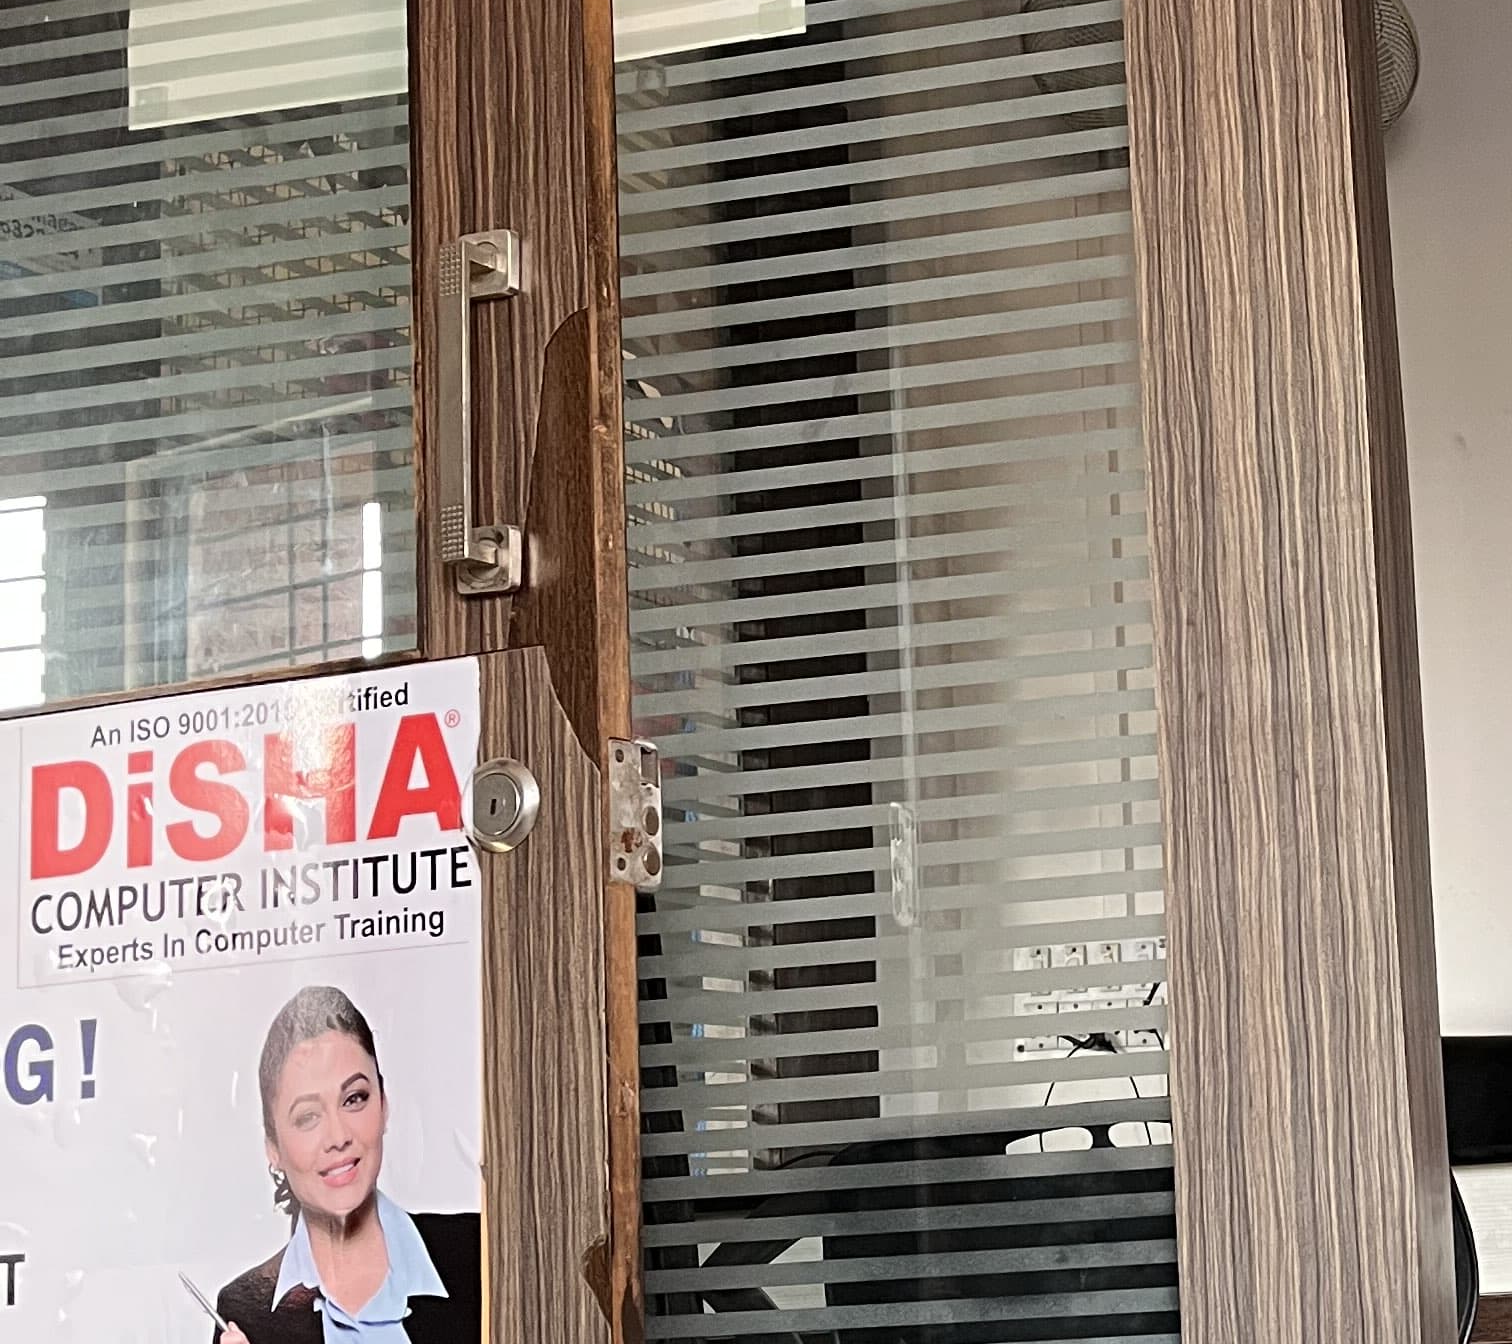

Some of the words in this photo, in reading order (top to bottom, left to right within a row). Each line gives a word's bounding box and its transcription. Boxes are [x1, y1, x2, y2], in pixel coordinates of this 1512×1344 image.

[91, 724, 122, 749] An
[130, 715, 171, 742] ISO
[31, 871, 246, 935] COMPUTER
[260, 844, 473, 910] INSTITUTE
[57, 937, 154, 973] Experts
[163, 933, 187, 960] In
[194, 920, 327, 958] Computer
[335, 907, 446, 941] Training
